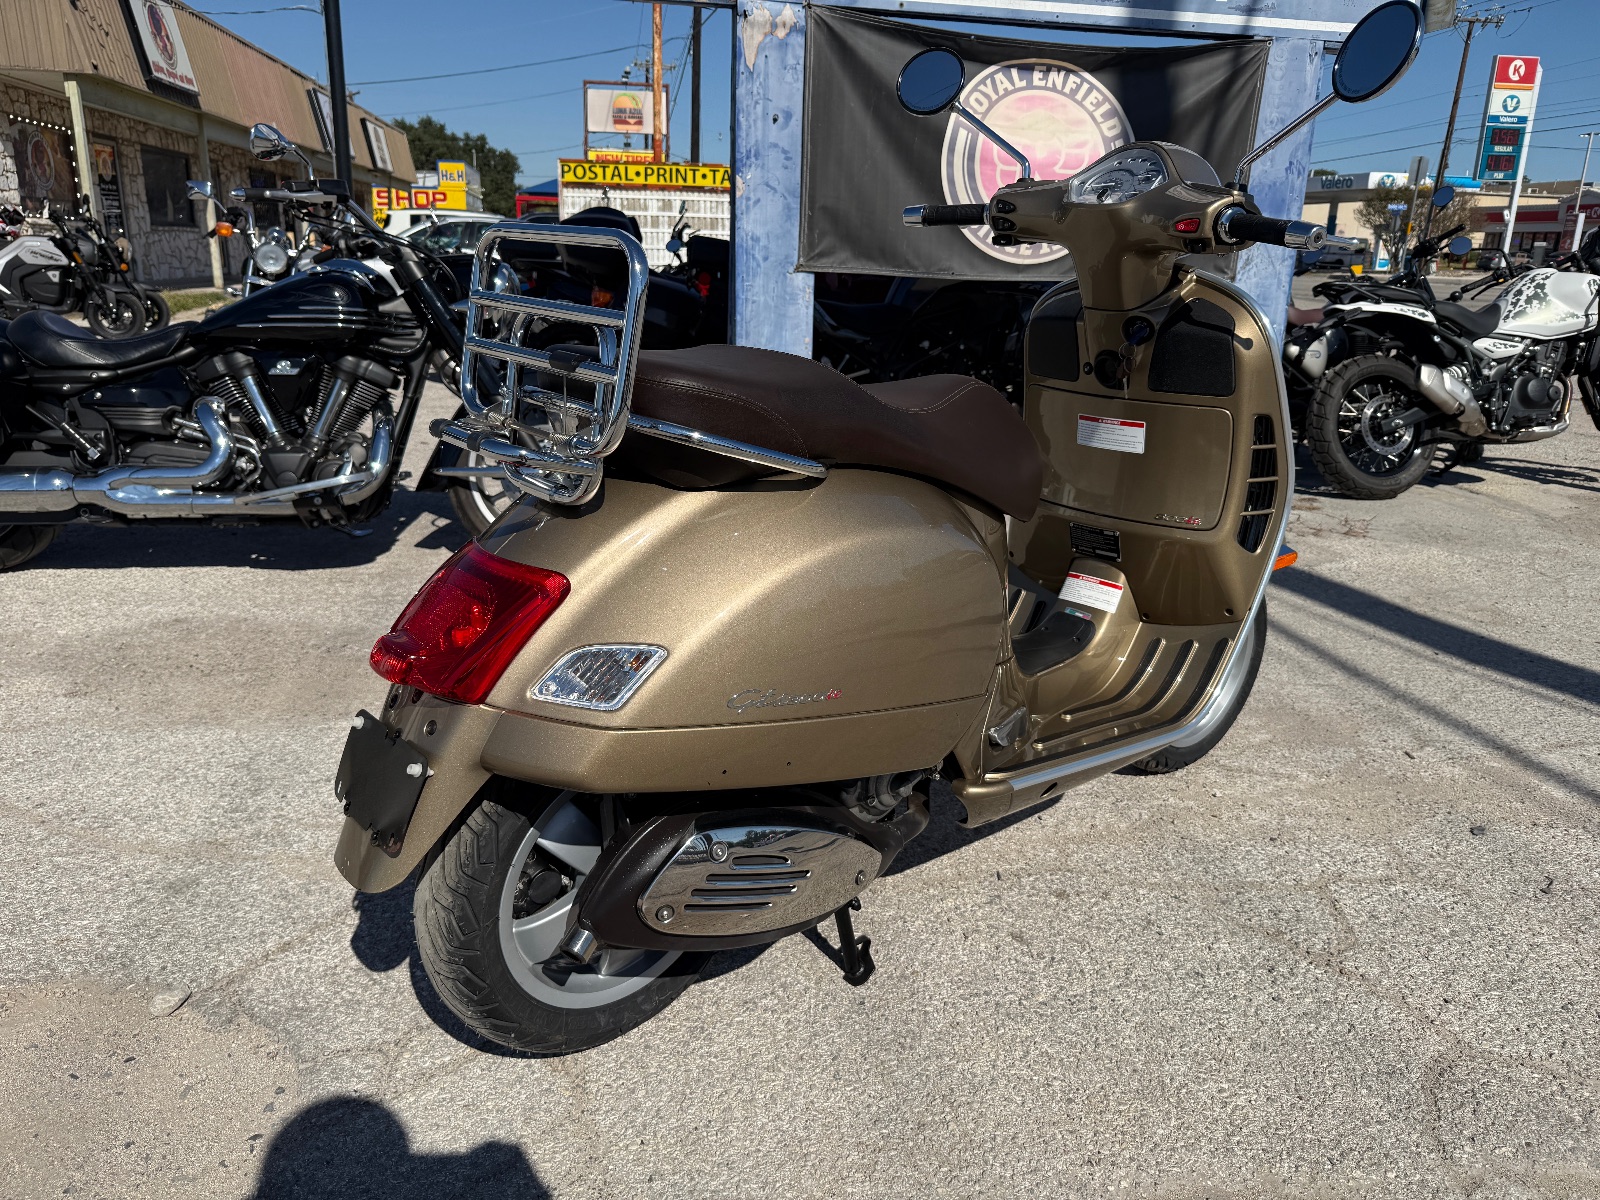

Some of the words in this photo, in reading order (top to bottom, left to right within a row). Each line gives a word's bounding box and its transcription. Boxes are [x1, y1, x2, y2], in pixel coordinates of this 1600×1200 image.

[1032, 65, 1123, 136] ENFIELD
[441, 170, 464, 182] H&H
[561, 163, 634, 182] POSTAL
[644, 166, 700, 184] PRINT
[1320, 175, 1354, 190] Valero
[376, 189, 447, 208] SHOP
